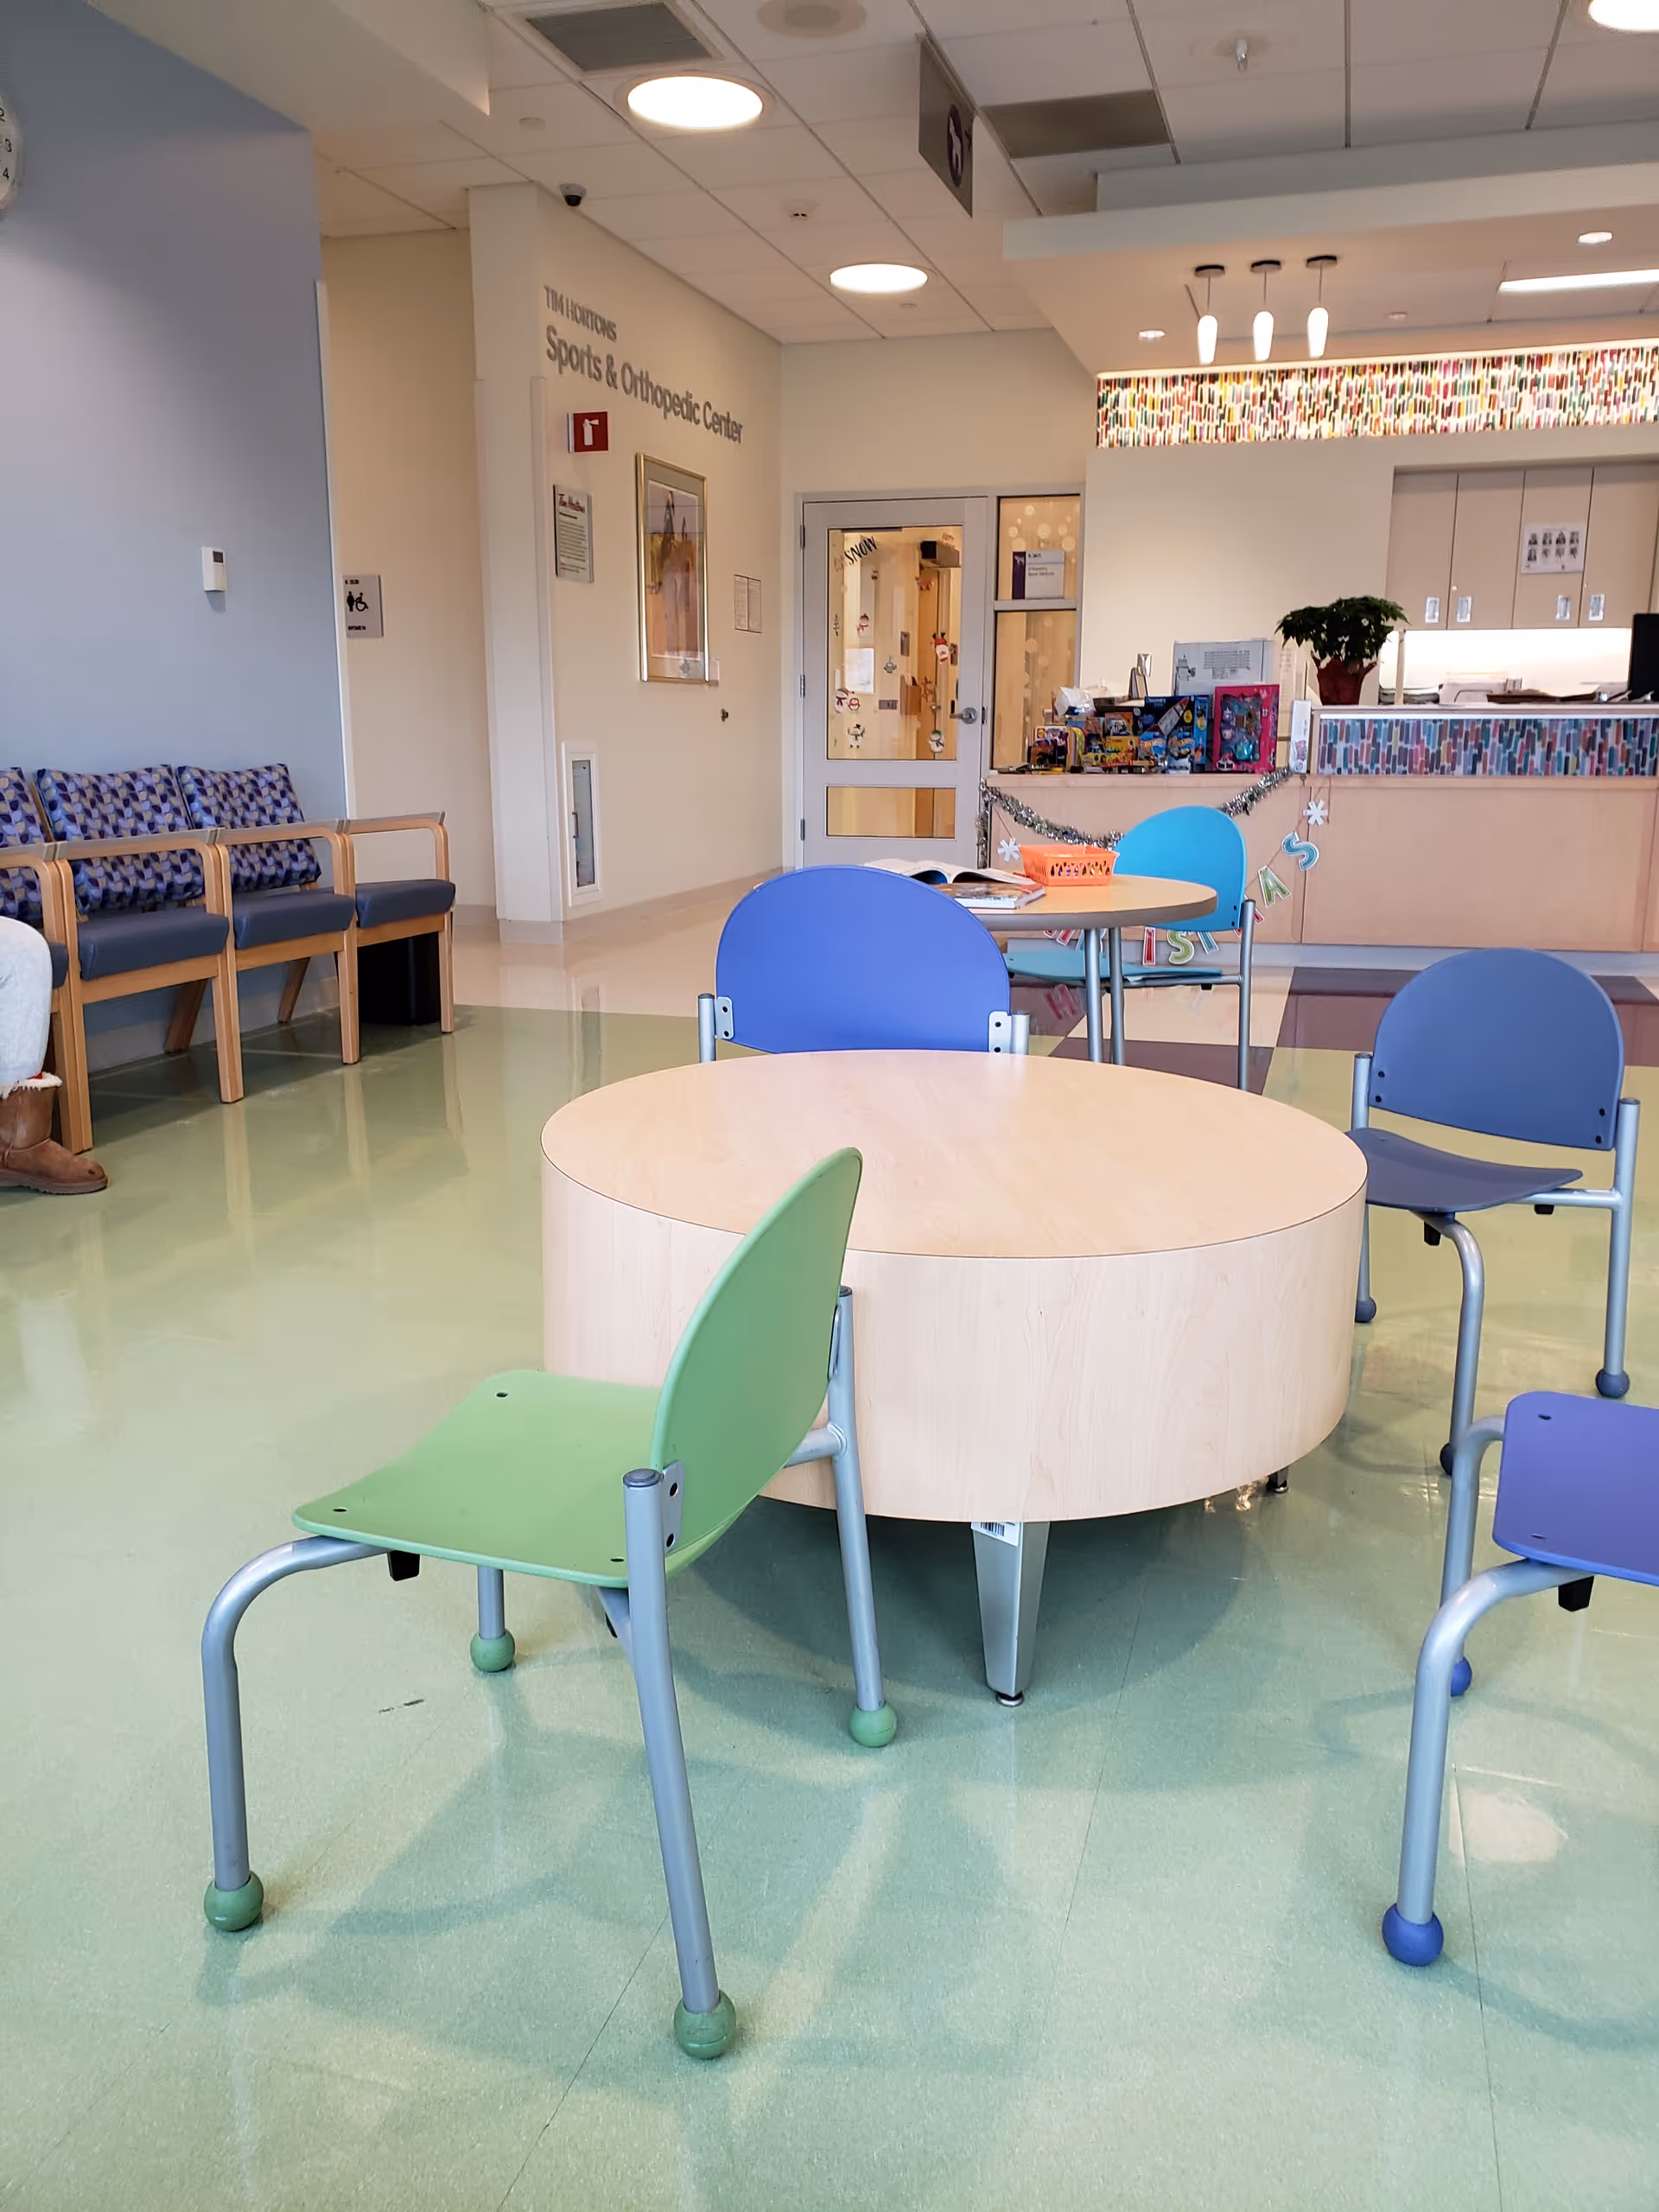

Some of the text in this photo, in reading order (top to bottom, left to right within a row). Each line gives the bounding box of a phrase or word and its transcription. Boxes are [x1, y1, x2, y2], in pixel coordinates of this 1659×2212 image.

[5, 138, 12, 152] 3
[3, 167, 10, 180] 4
[543, 284, 617, 342] TIM HORTONS
[546, 325, 743, 443] Sports & Orthopedic Center
[843, 535, 878, 566] SNOW
